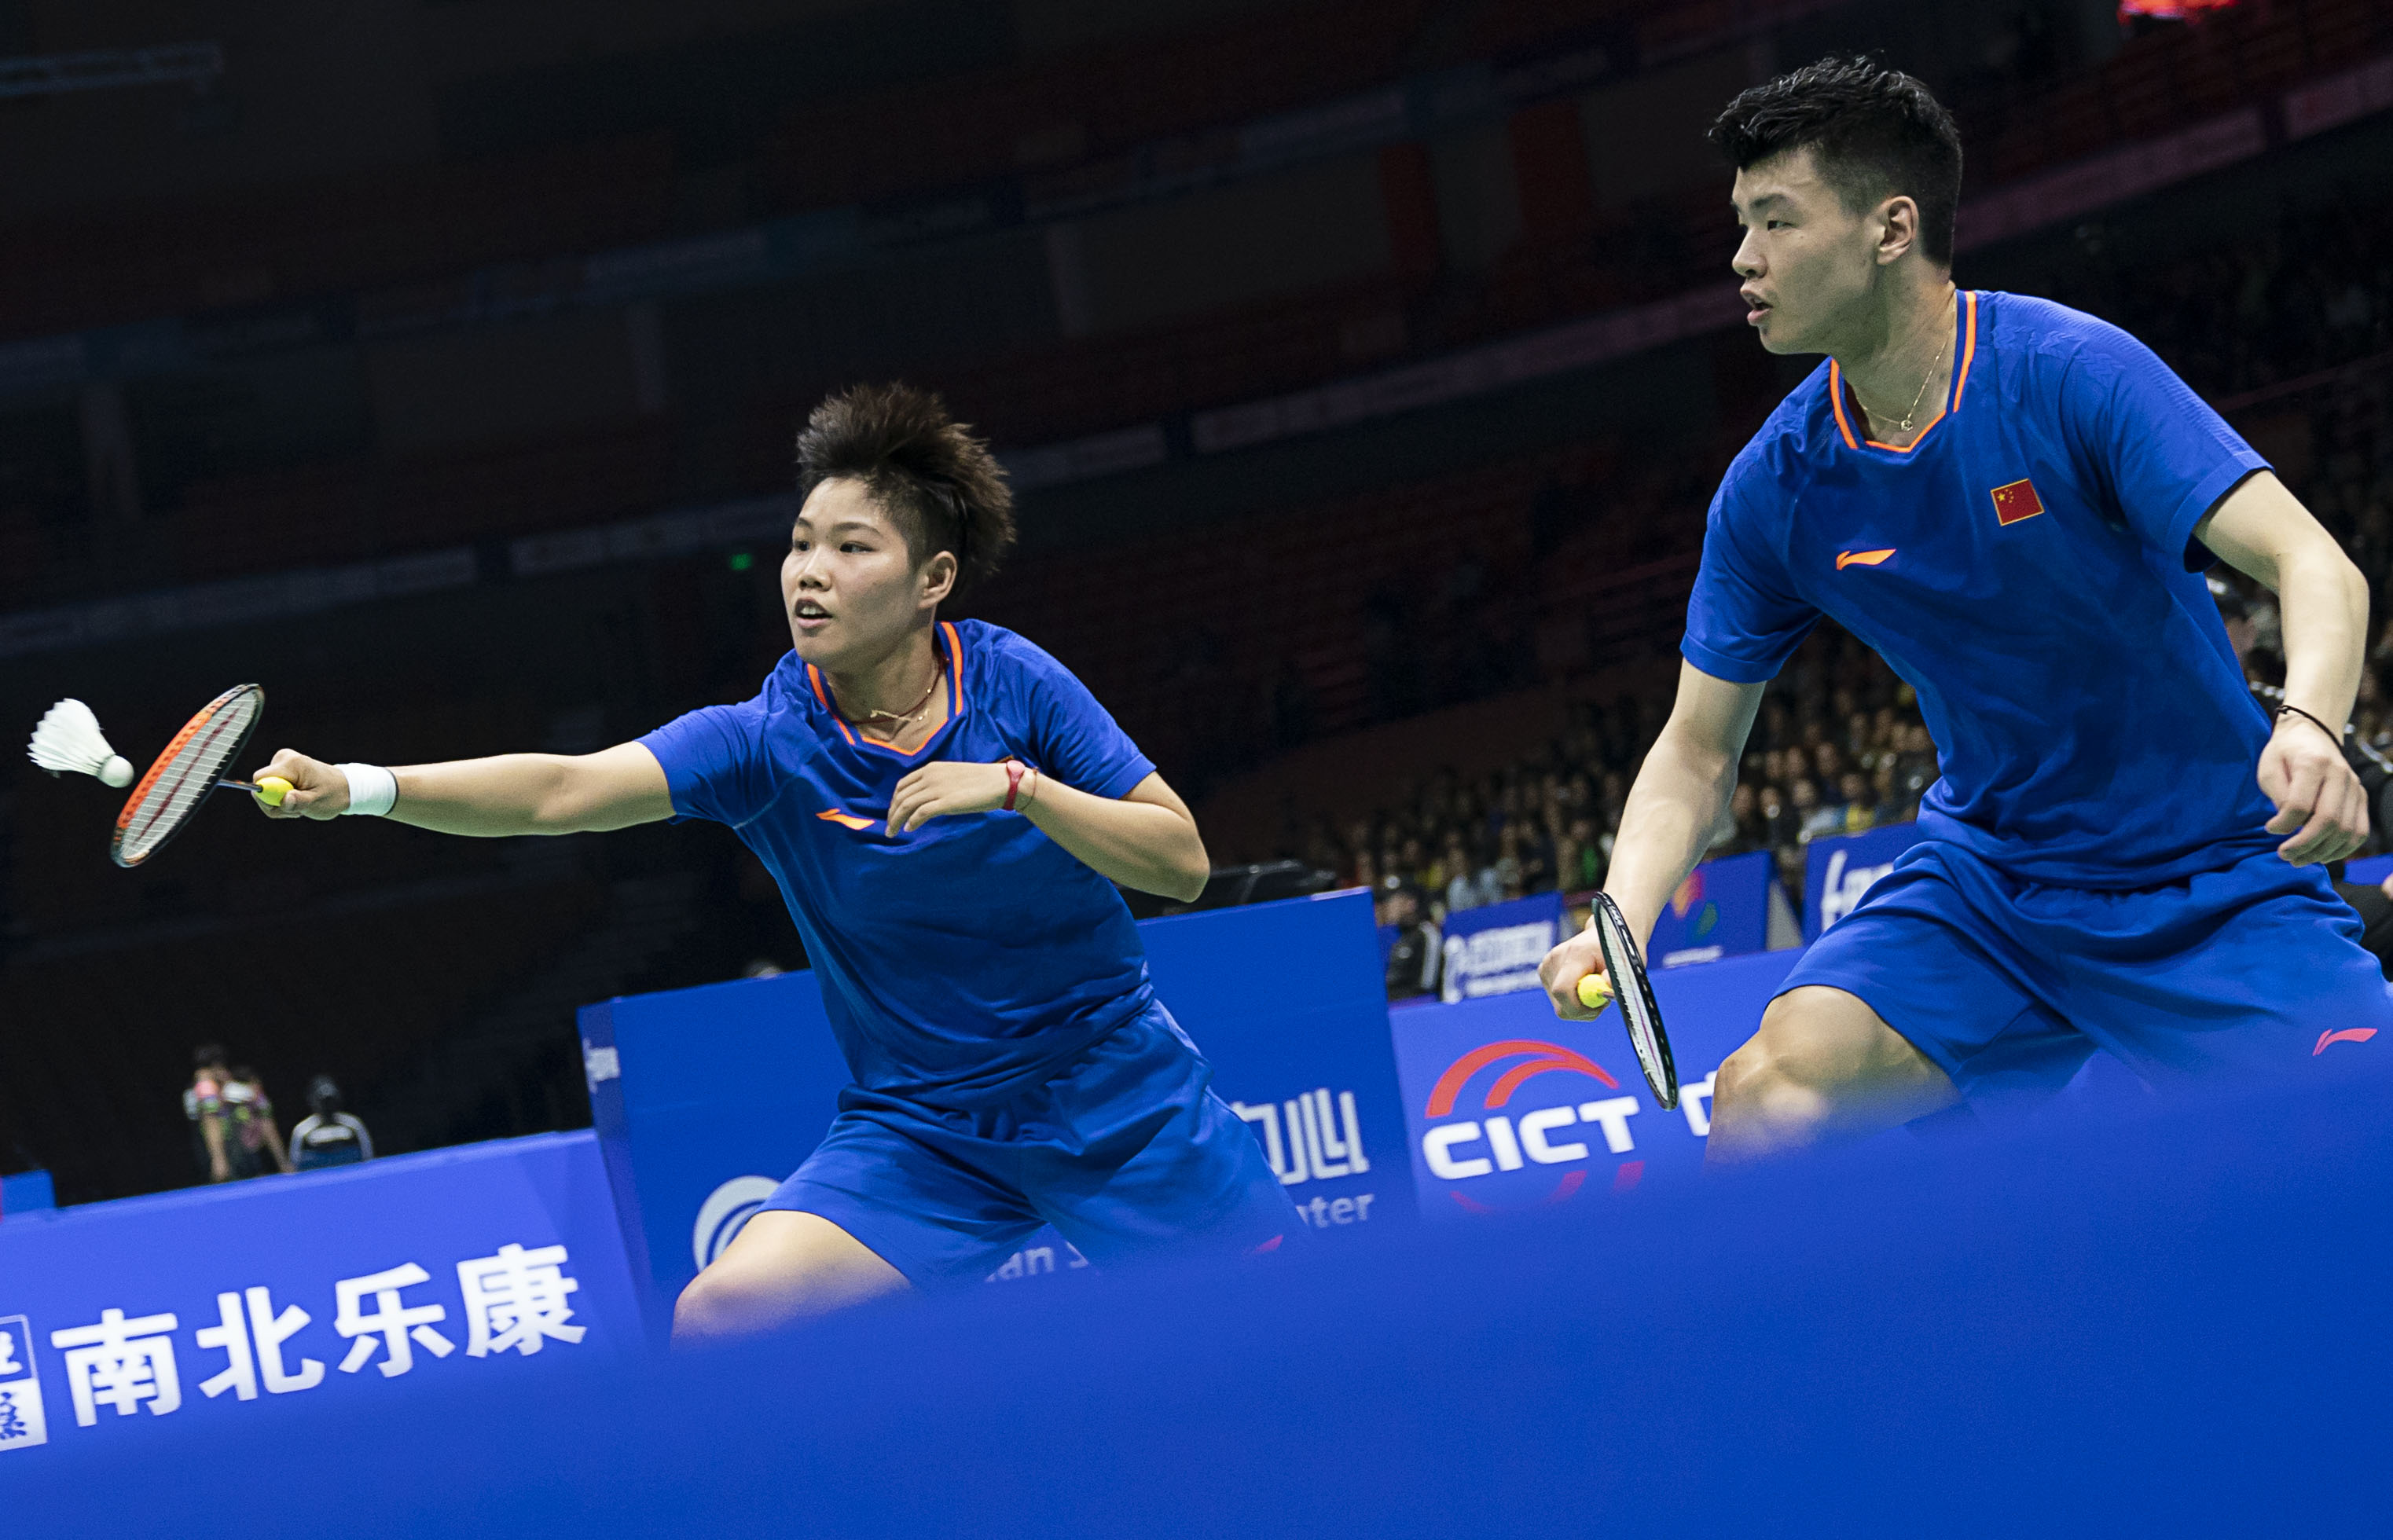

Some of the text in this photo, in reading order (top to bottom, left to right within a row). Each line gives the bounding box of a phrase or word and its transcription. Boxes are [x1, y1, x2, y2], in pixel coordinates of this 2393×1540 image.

[1422, 1096, 1641, 1180] CICT
[50, 1243, 587, 1427] 南北乐康
